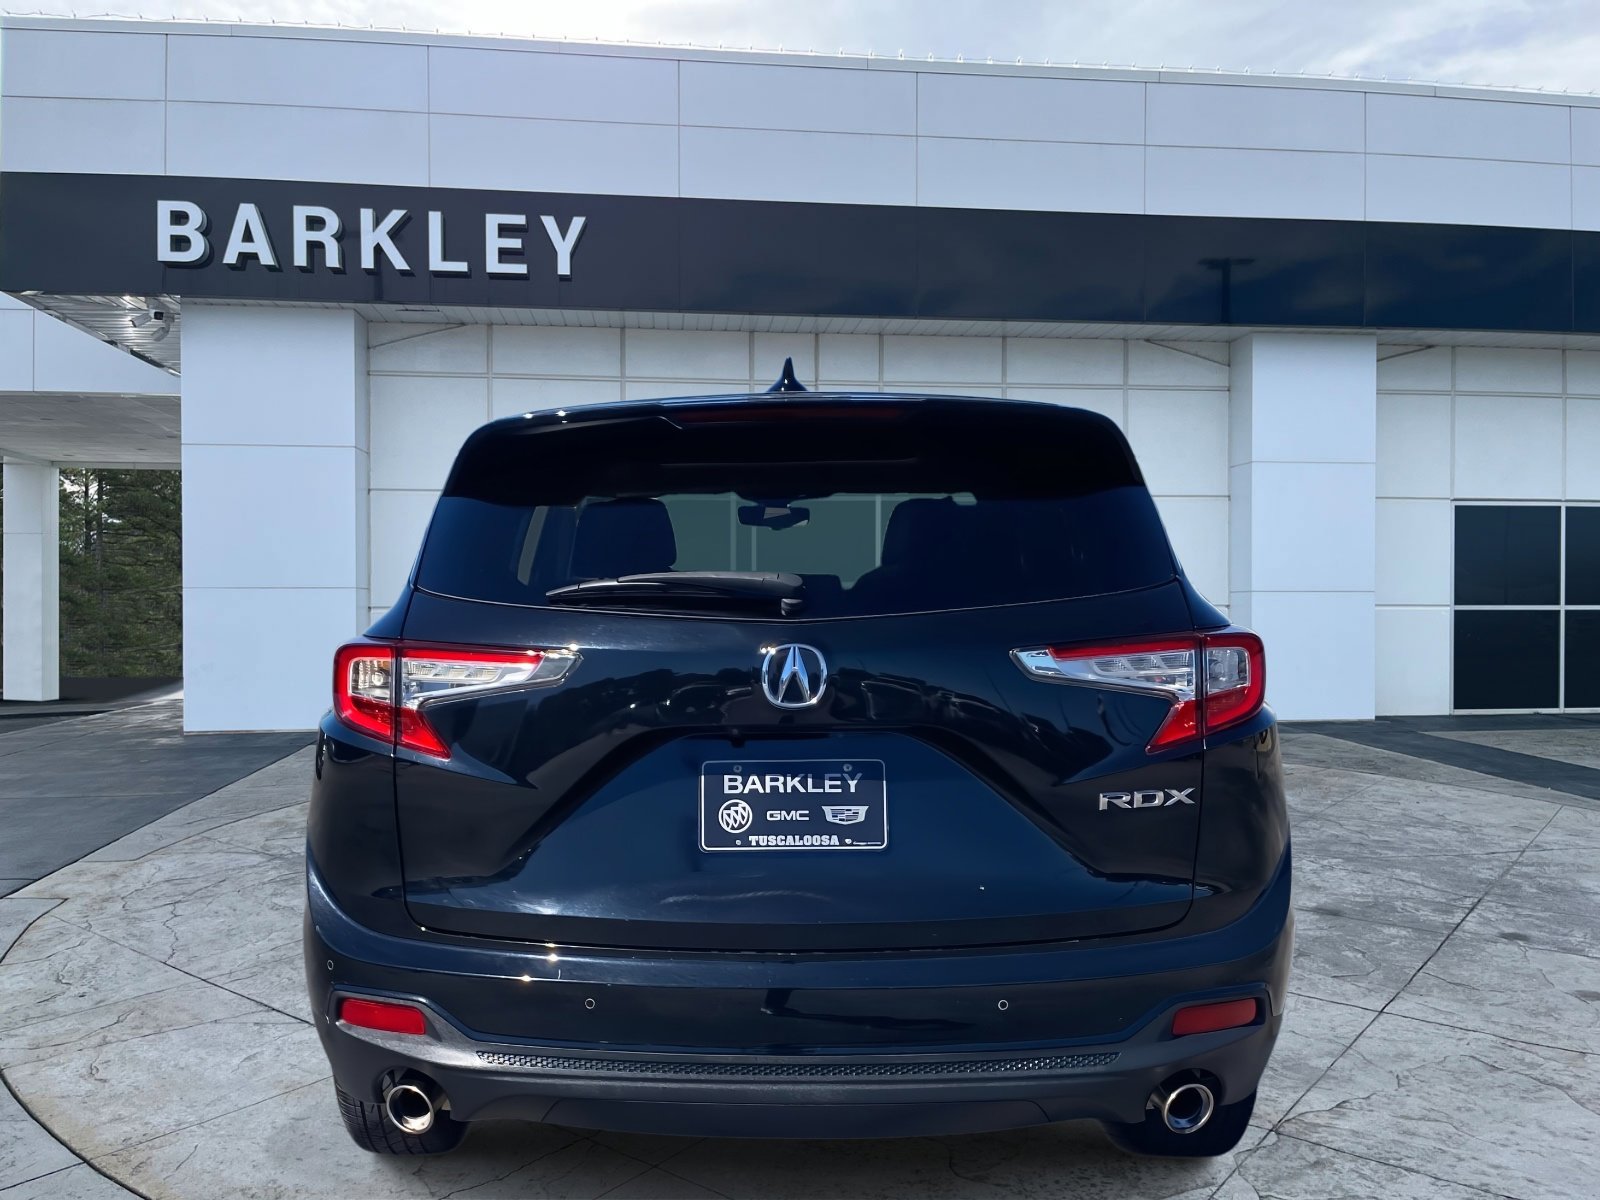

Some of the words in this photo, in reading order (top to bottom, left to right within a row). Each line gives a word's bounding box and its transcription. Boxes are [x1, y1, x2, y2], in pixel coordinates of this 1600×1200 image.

[156, 199, 588, 279] BARKLEY
[723, 773, 863, 794] BARKLEY
[1098, 787, 1196, 811] RDX
[766, 810, 810, 821] GMC
[748, 834, 840, 846] TUSCALOOSA
